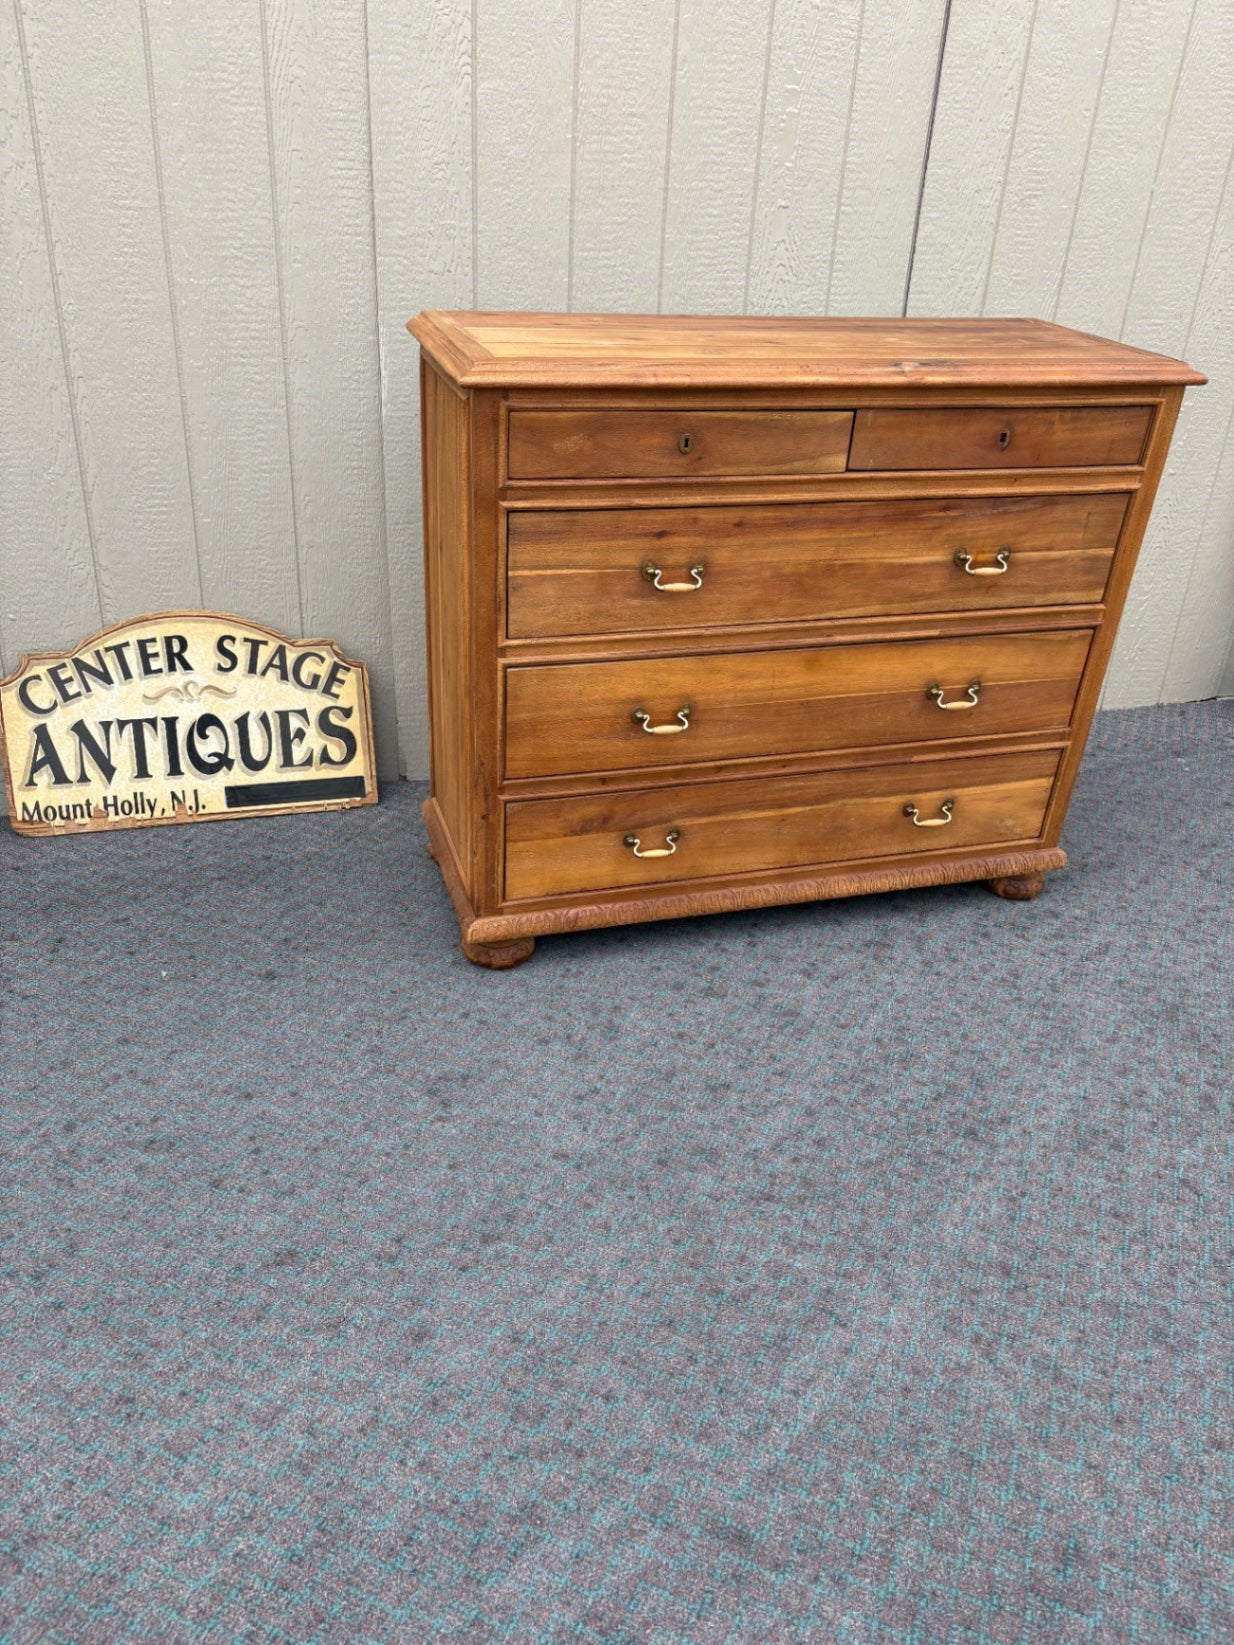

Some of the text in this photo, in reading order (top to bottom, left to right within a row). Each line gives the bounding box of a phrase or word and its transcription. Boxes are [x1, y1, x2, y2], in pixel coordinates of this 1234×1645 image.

[19, 634, 350, 715] CENTER STAGE
[25, 705, 357, 787] ANTIQUES
[22, 789, 207, 822] Mount Holly, N.J.
